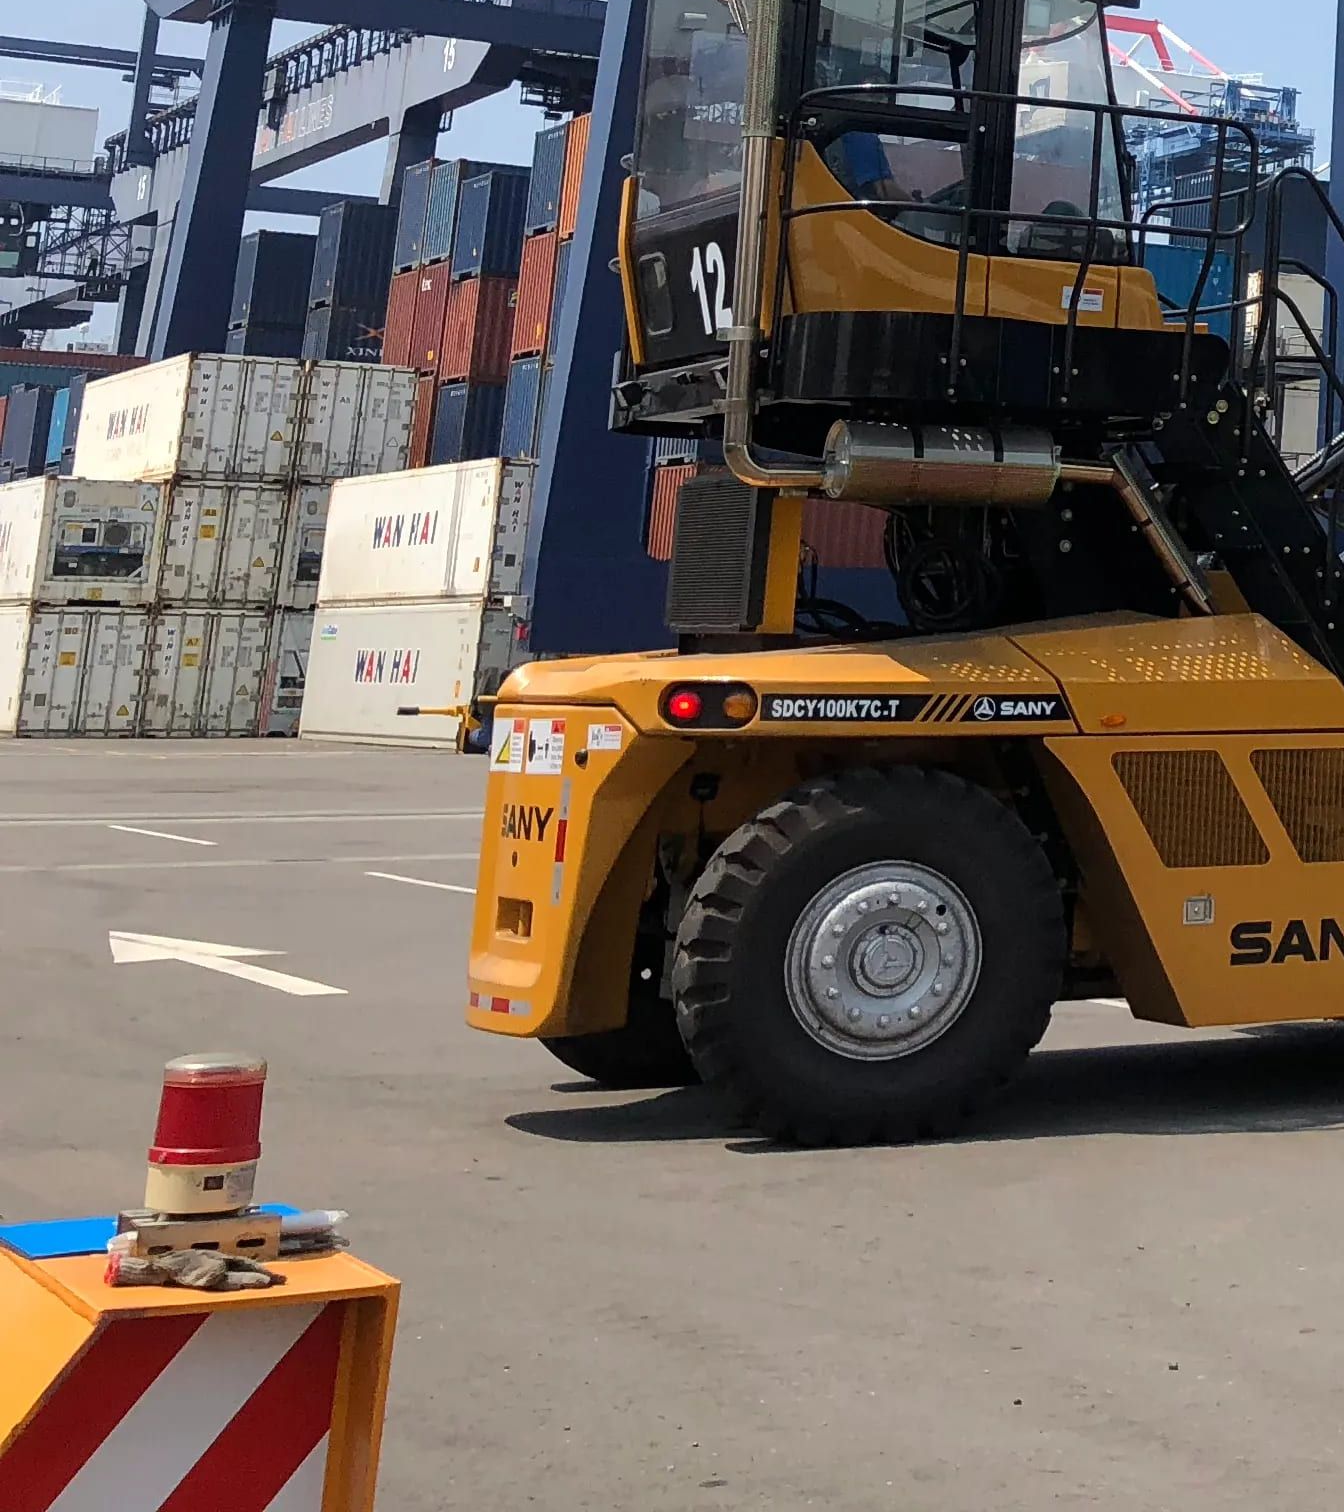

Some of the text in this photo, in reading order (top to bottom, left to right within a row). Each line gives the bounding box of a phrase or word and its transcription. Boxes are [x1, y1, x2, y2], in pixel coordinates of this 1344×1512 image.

[689, 242, 734, 337] 12
[107, 402, 150, 441] WAN HAI
[373, 510, 439, 550] WAN HAI
[354, 649, 421, 684] WAN HAI
[771, 698, 900, 720] SDCY100K7C-T
[1000, 700, 1057, 717] SANY
